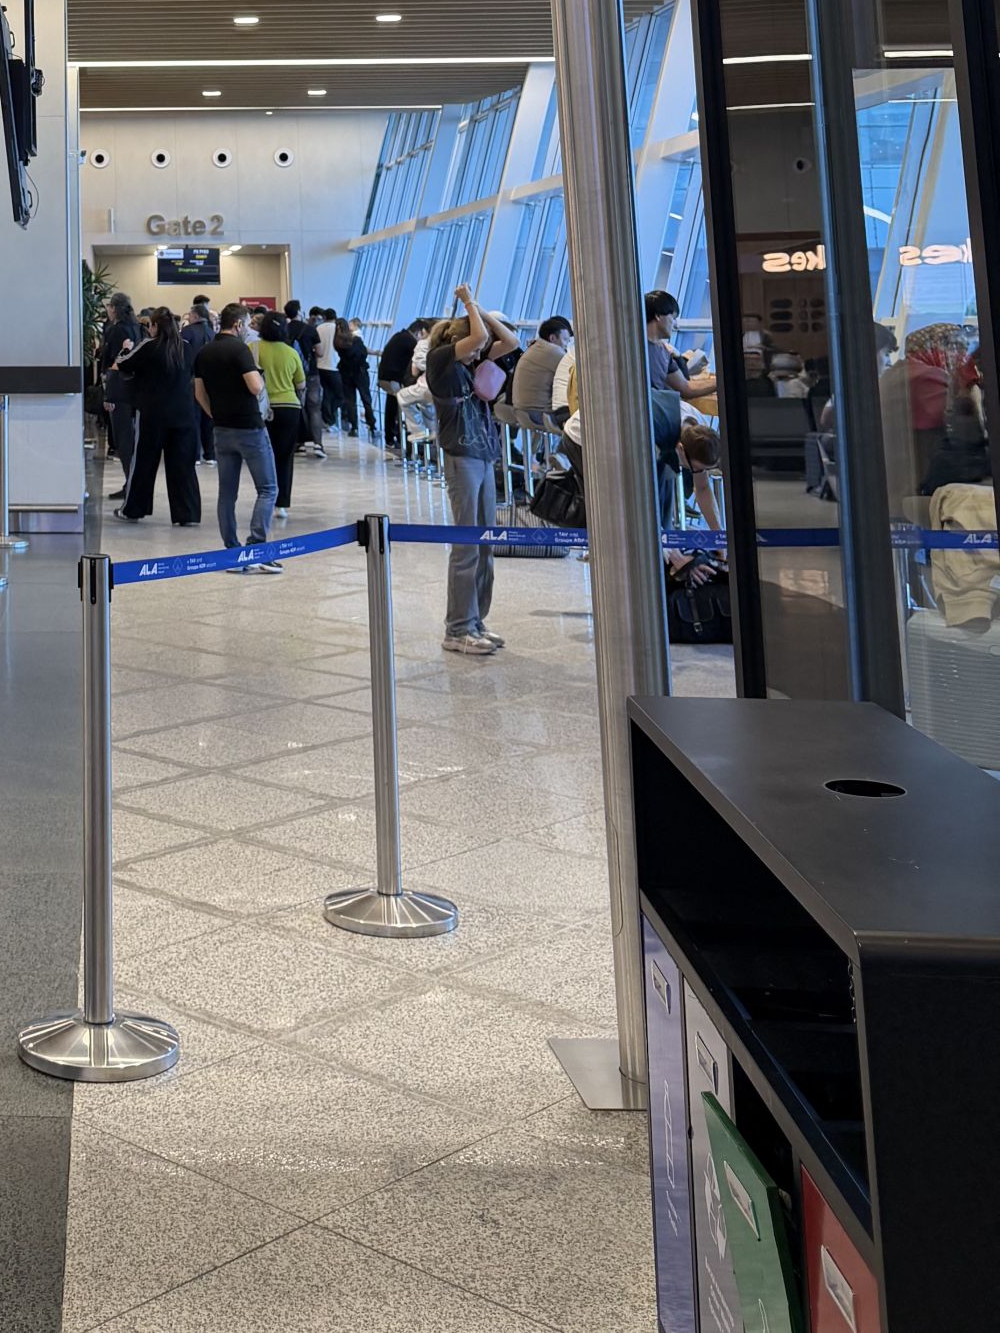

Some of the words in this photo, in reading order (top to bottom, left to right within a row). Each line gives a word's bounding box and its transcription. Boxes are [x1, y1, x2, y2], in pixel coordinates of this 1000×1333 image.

[146, 214, 206, 236] Gate
[209, 214, 225, 235] 2
[480, 530, 508, 540] ALA
[963, 533, 993, 543] ALA
[237, 549, 254, 563] ALA
[139, 562, 158, 576] ALA
